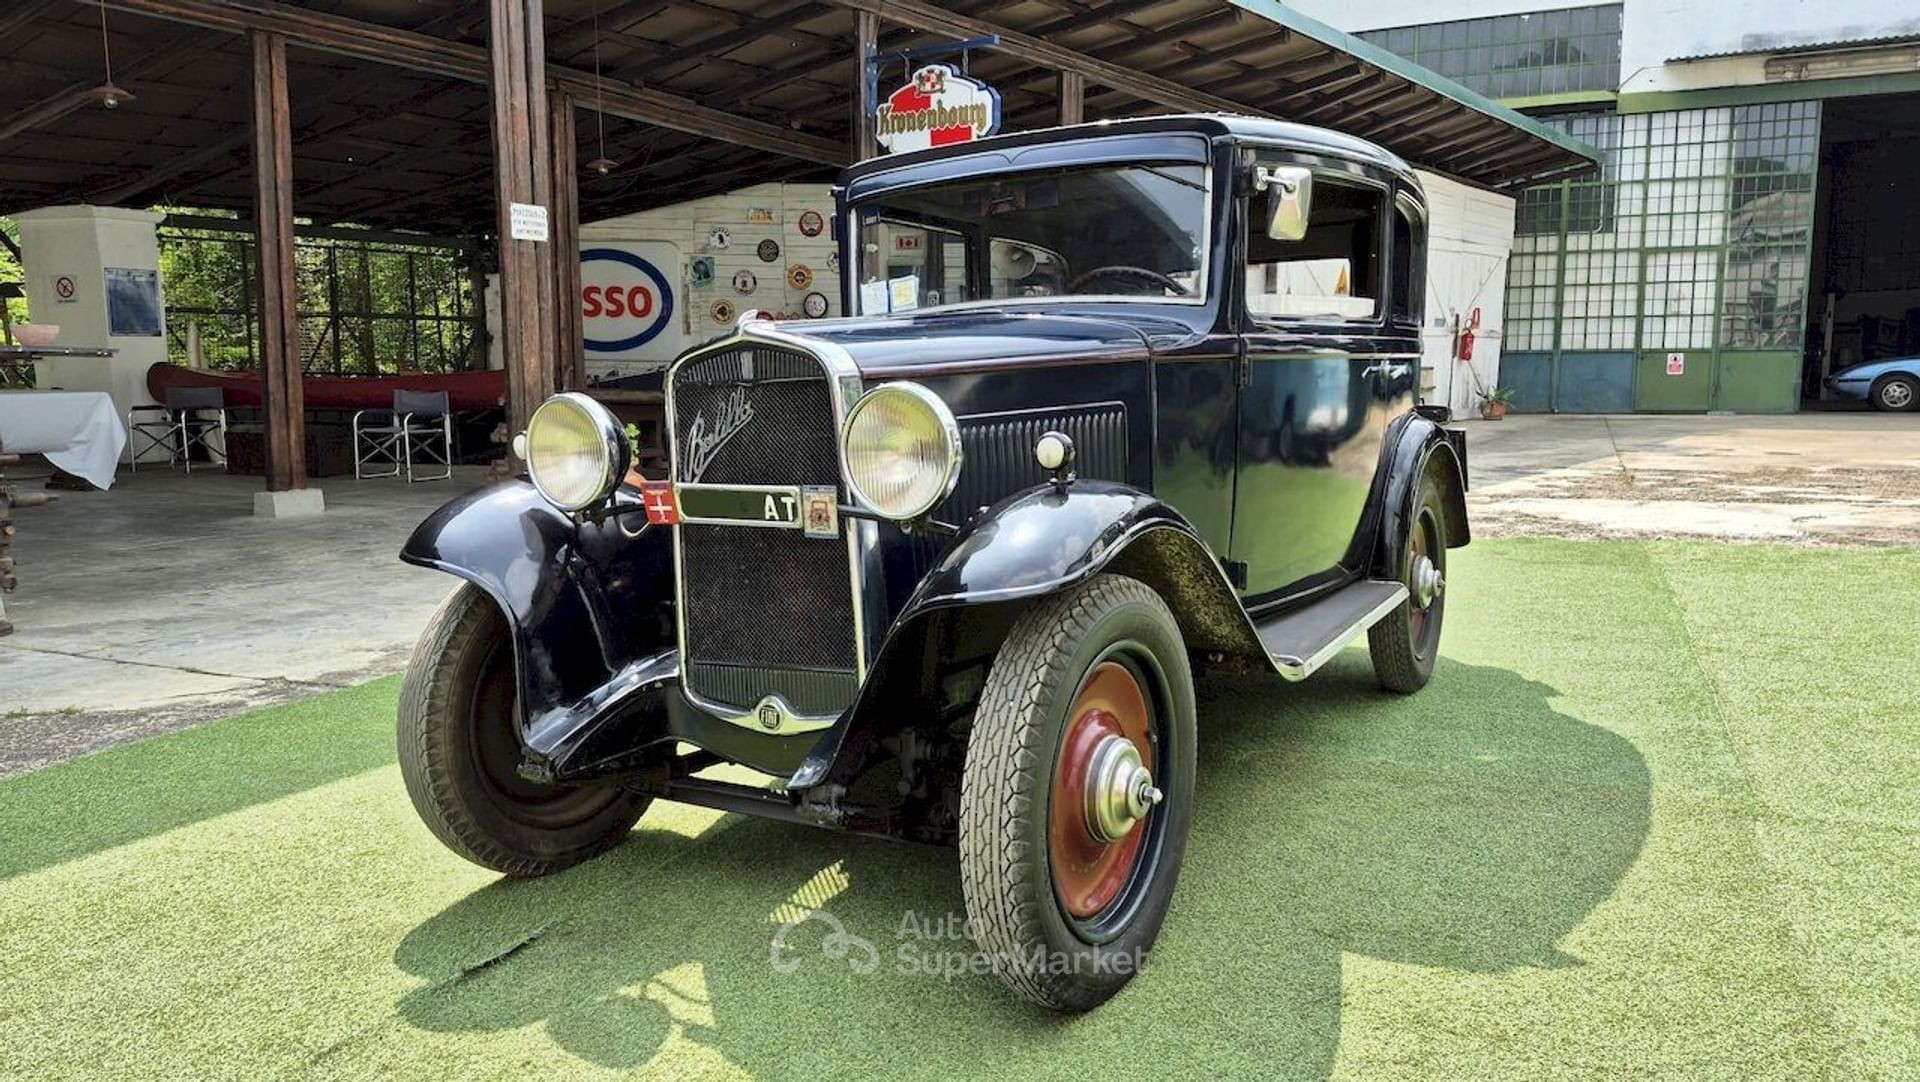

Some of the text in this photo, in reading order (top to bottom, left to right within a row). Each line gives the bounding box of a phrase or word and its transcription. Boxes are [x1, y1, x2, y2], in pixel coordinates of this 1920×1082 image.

[878, 99, 987, 136] Kronenbourg
[583, 286, 652, 318] SSO
[764, 494, 796, 522] AT
